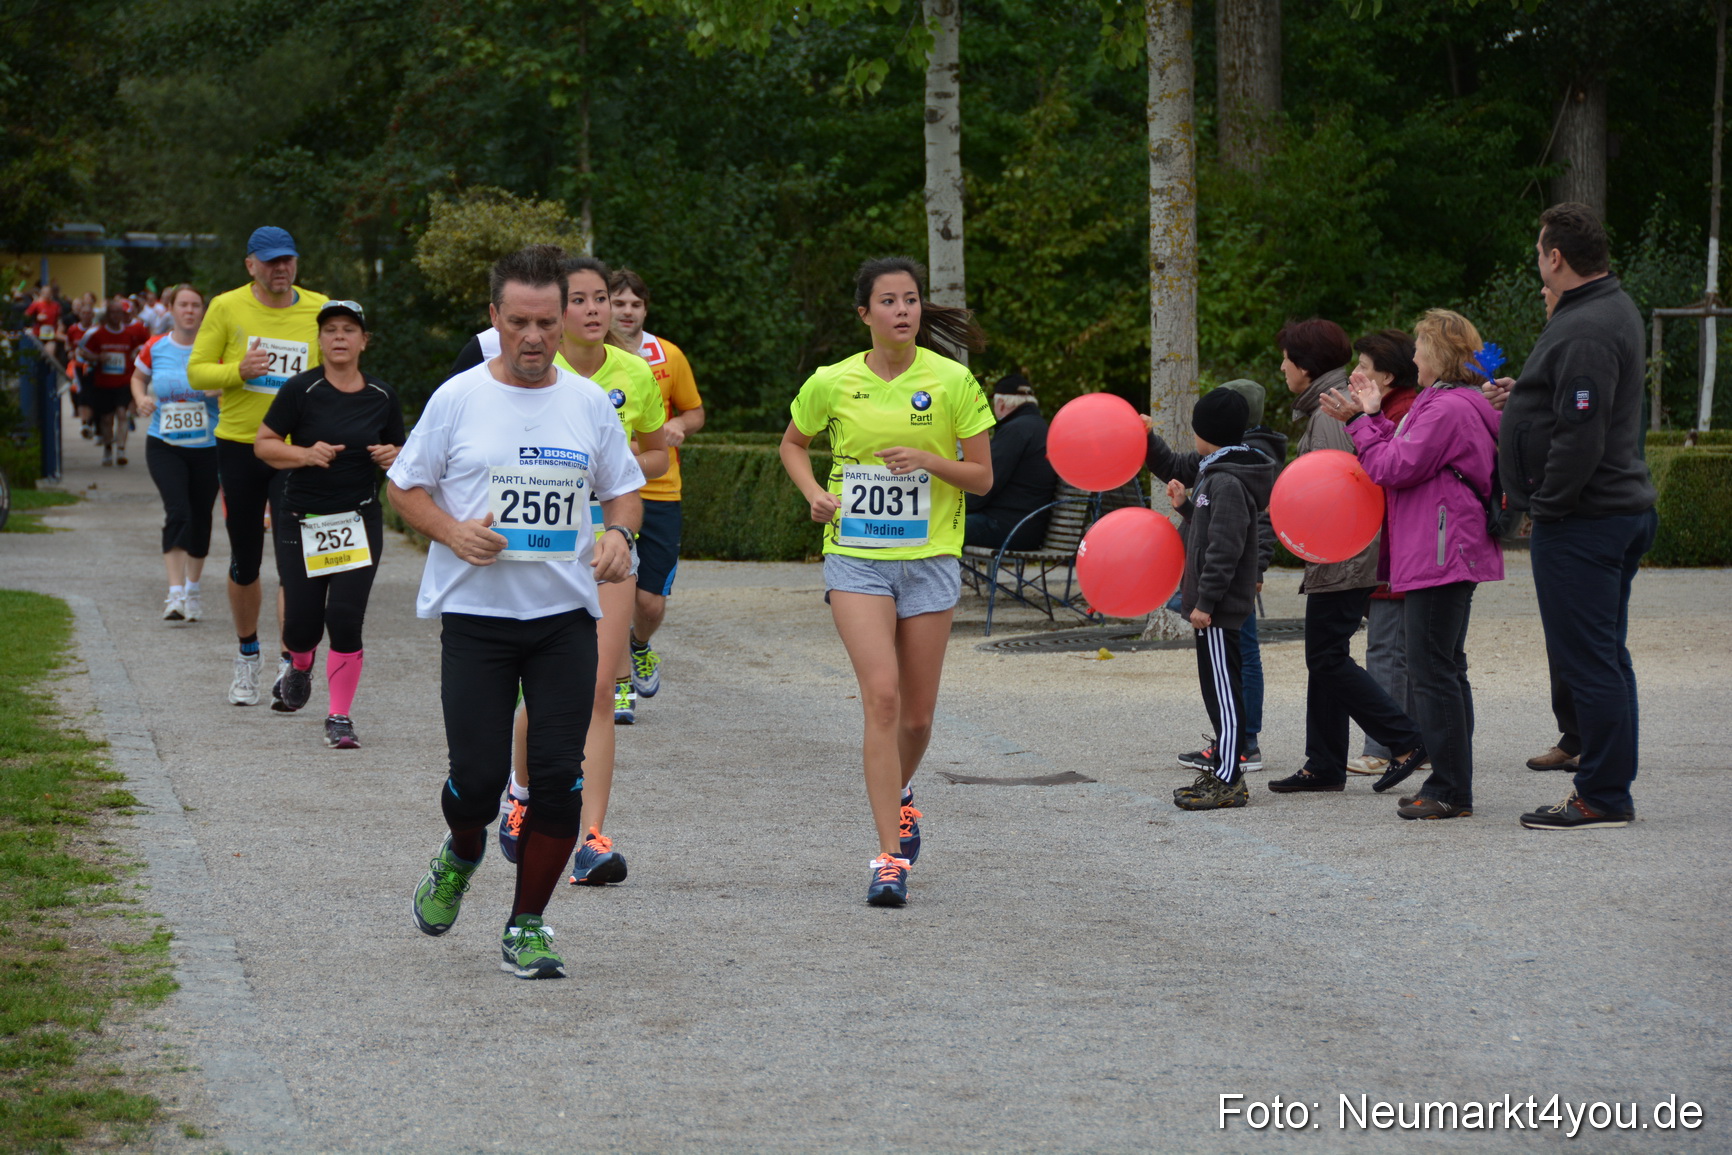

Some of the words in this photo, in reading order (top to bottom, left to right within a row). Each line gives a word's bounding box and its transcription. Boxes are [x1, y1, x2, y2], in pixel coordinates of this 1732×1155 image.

[271, 344, 299, 352] Neumarkt
[267, 352, 302, 374] 214
[653, 369, 670, 380] GL
[165, 411, 203, 430] 2589
[617, 411, 625, 419] rtl
[910, 413, 933, 422] Partl
[544, 449, 587, 464] BÜSCHEL
[492, 475, 526, 485] PARTL
[529, 476, 574, 488] Neumarkt
[845, 471, 872, 481] PARTL
[873, 473, 916, 482] Neumarkt
[850, 484, 919, 516] 2031
[500, 489, 575, 526] 2561
[321, 518, 352, 528] Neumarkt
[864, 523, 905, 536] Nadine
[315, 527, 355, 552] 252
[528, 534, 551, 549] Udo
[324, 553, 352, 565] Angela
